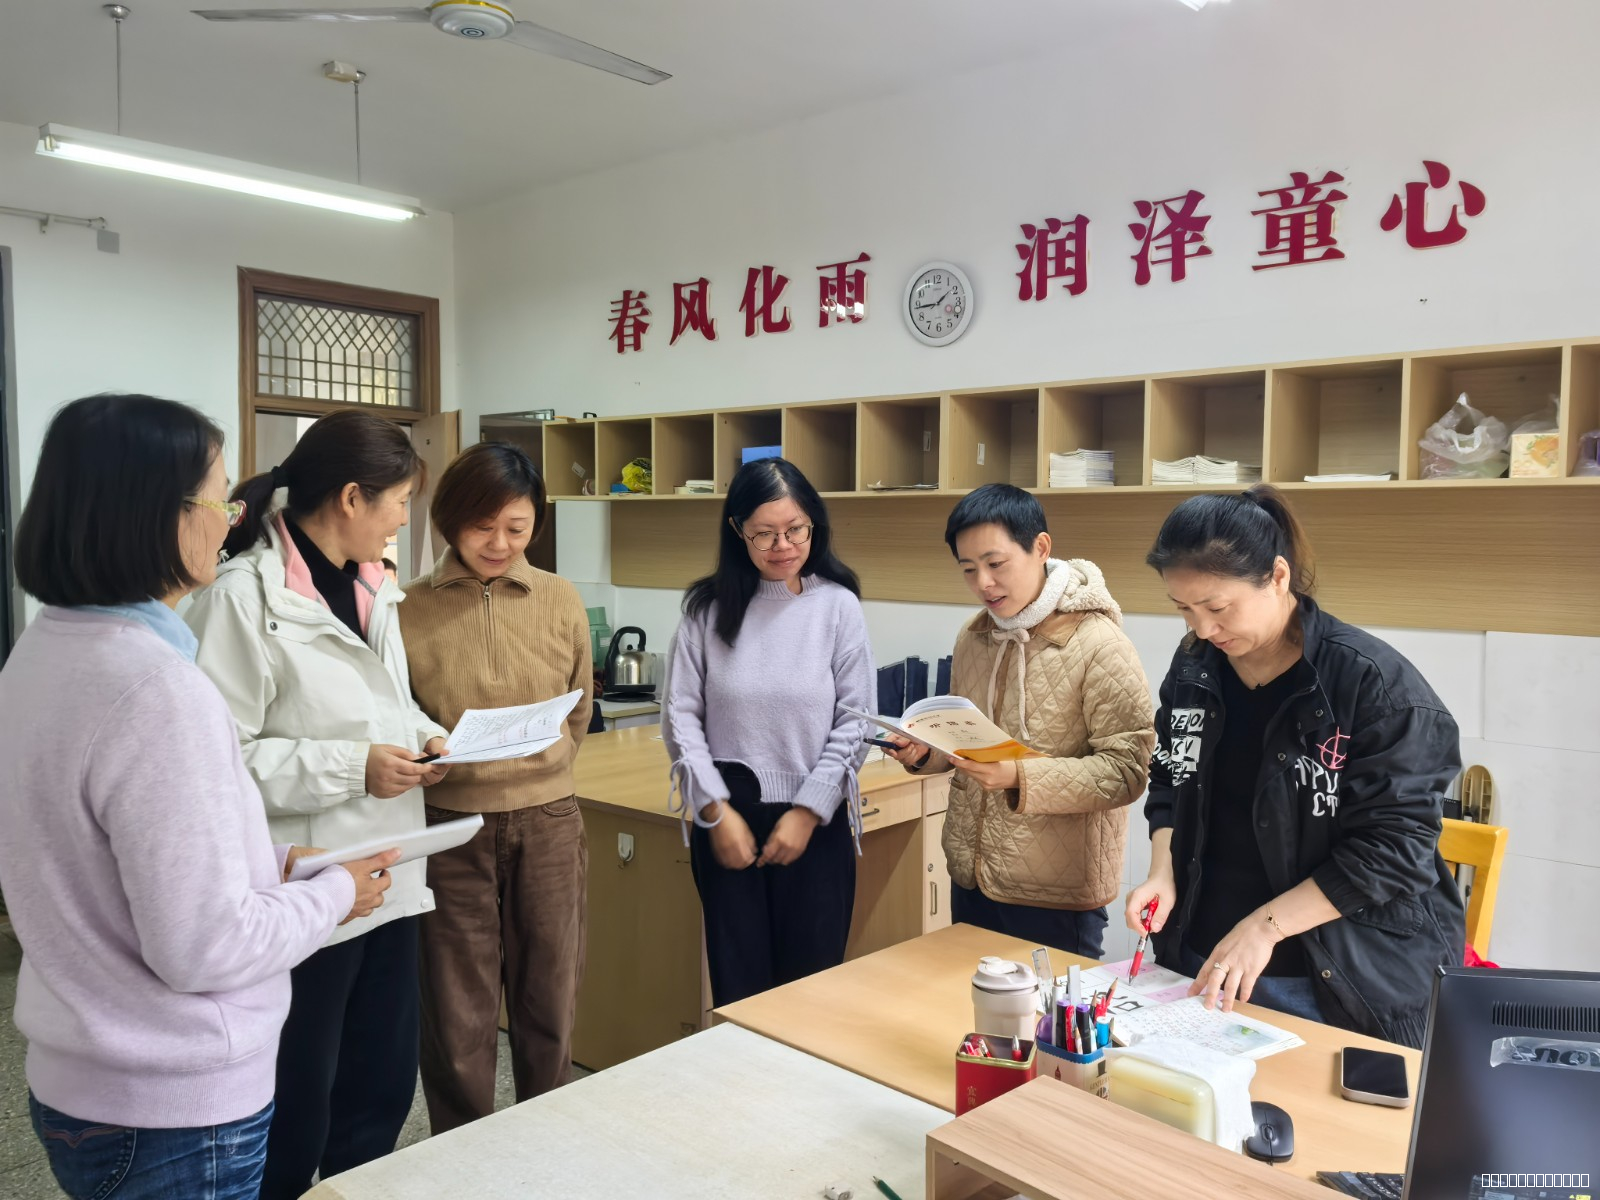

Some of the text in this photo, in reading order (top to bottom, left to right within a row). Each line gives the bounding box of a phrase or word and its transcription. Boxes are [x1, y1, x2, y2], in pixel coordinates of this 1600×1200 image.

[609, 160, 1486, 353] 春风化雨 润泽童心
[933, 275, 942, 284] 12
[918, 289, 925, 298] 10
[952, 286, 958, 295] 2
[955, 297, 961, 306] 3
[919, 312, 924, 321] 8
[926, 321, 931, 330] 7
[936, 323, 942, 332] 6
[947, 319, 953, 328] 5
